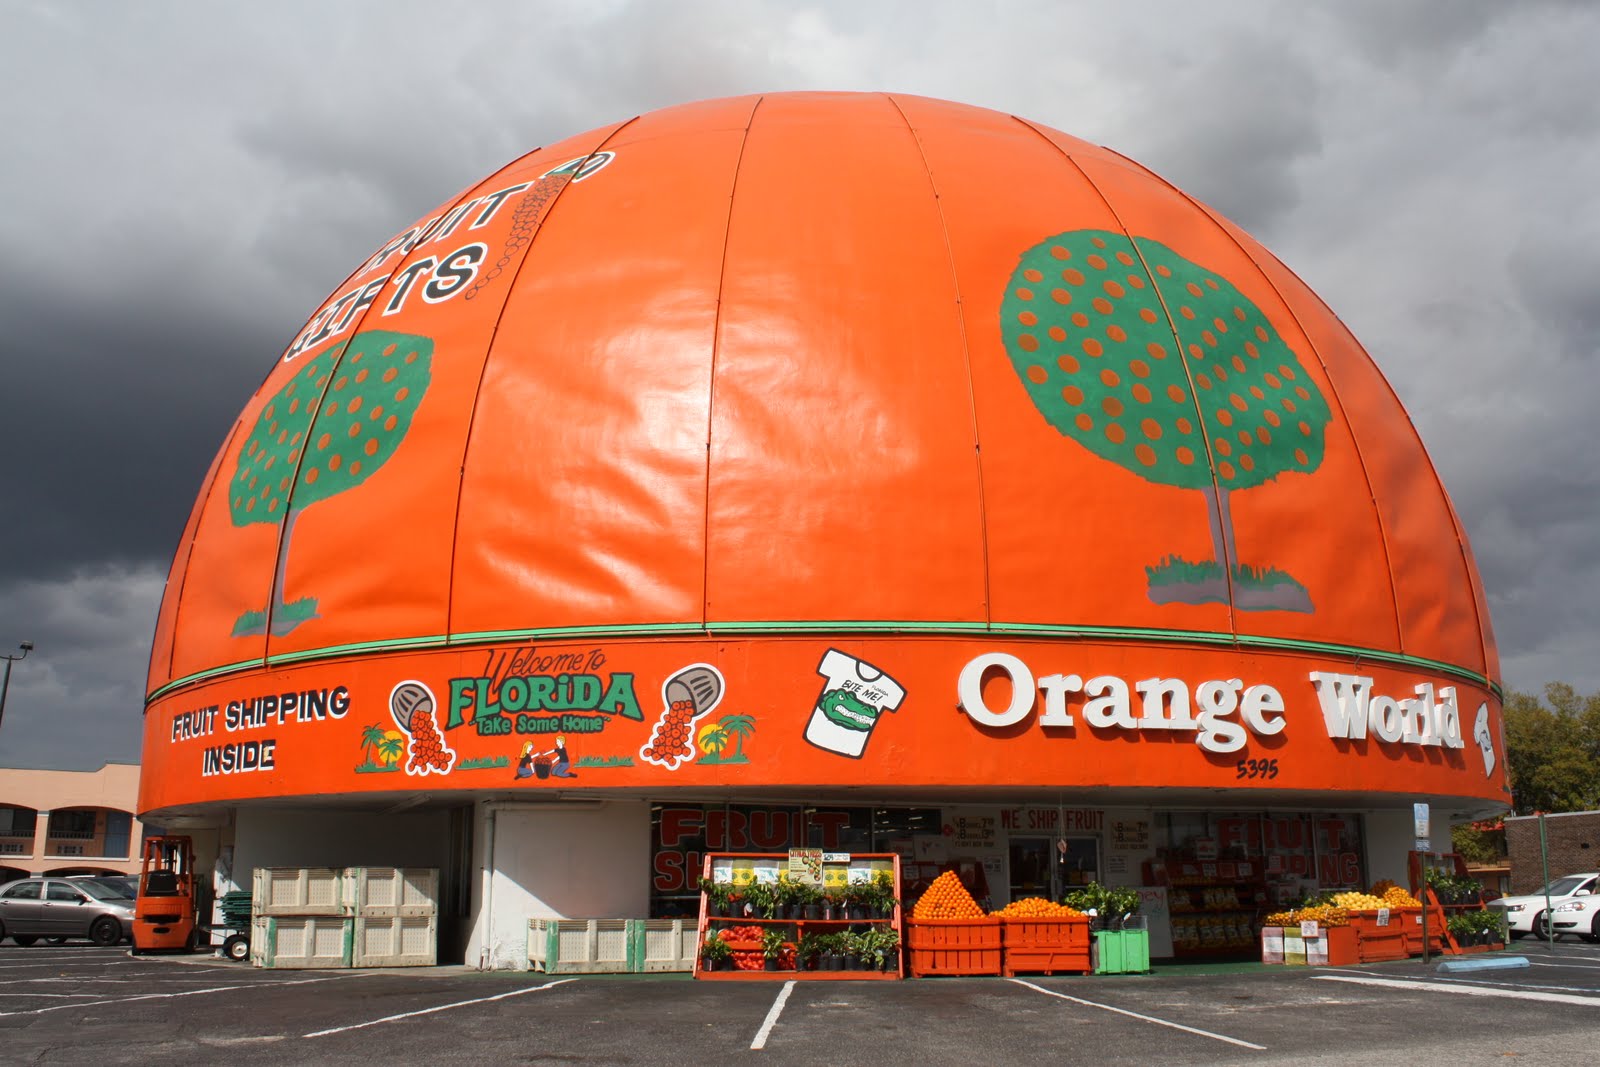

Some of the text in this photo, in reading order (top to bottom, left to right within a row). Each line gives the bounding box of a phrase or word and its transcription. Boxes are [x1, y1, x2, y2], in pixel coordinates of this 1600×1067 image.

[483, 647, 582, 694] Welcome
[841, 680, 883, 704] BITE ME!
[957, 652, 1465, 753] Orange World
[171, 686, 350, 743] FRUIT SHIPPING
[516, 714, 559, 734] Some
[202, 739, 276, 776] INSIDE
[1236, 758, 1279, 779] 5395
[660, 808, 849, 848] FRUIT
[1001, 809, 1021, 829] WE
[1028, 809, 1058, 829] SHIP
[1066, 810, 1104, 830] FRUIT
